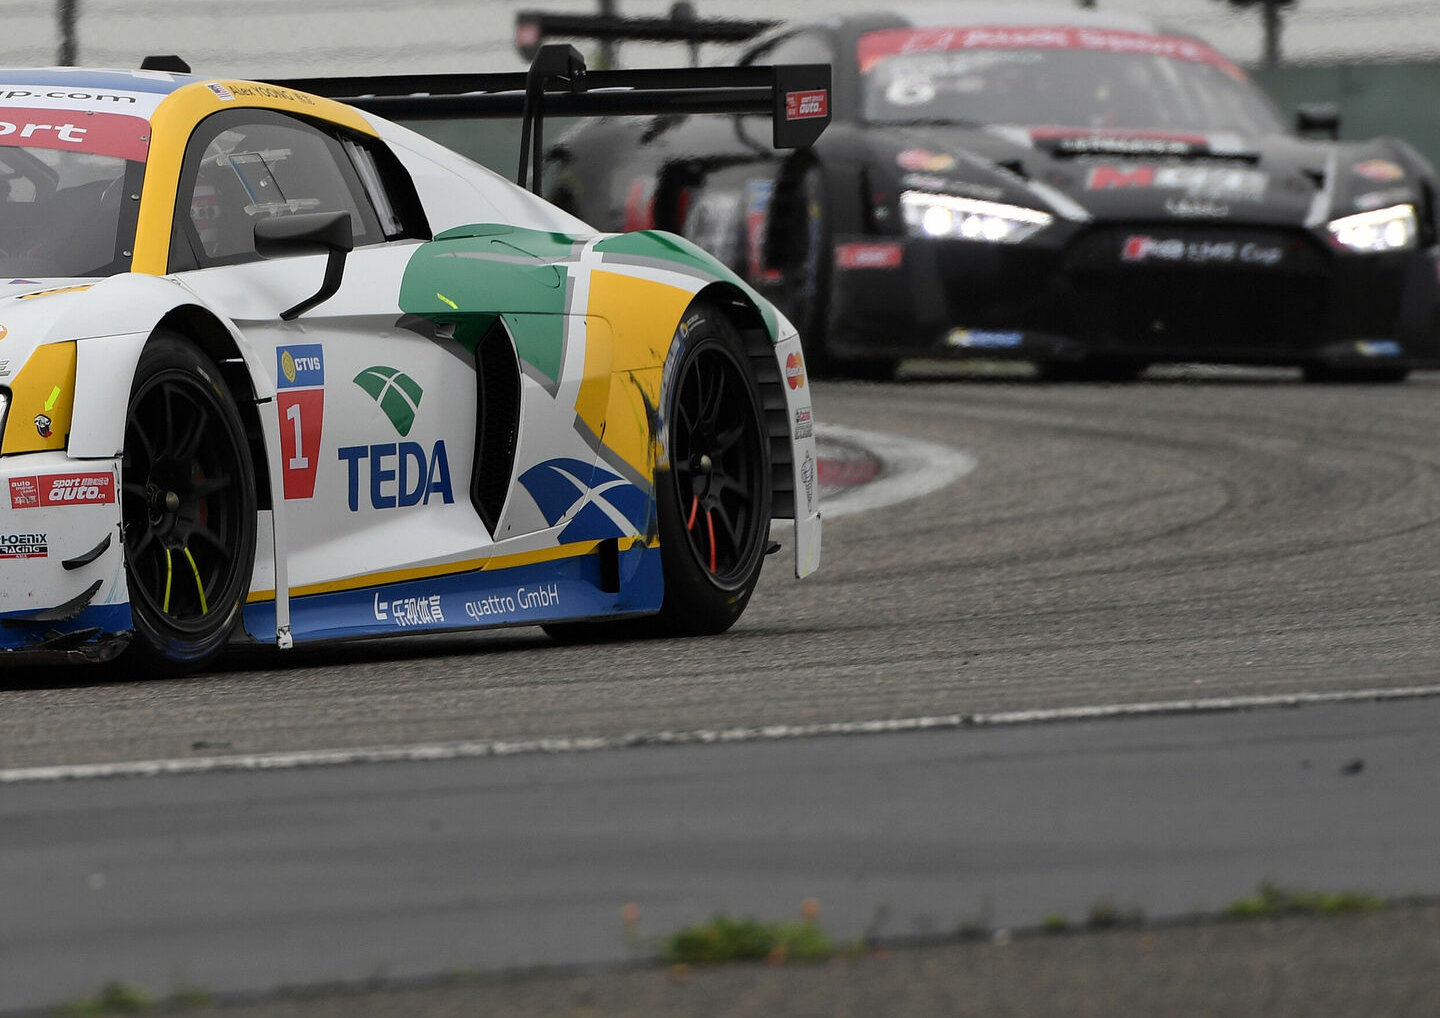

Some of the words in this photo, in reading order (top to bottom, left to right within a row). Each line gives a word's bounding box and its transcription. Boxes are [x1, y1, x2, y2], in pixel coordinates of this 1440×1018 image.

[294, 357, 321, 372] CTVS
[286, 403, 309, 470] 1
[52, 477, 80, 489] sport
[338, 440, 455, 512] TEDA
[392, 594, 445, 627] 乐视体育
[465, 594, 516, 622] quattro
[517, 583, 560, 610] GmbH
